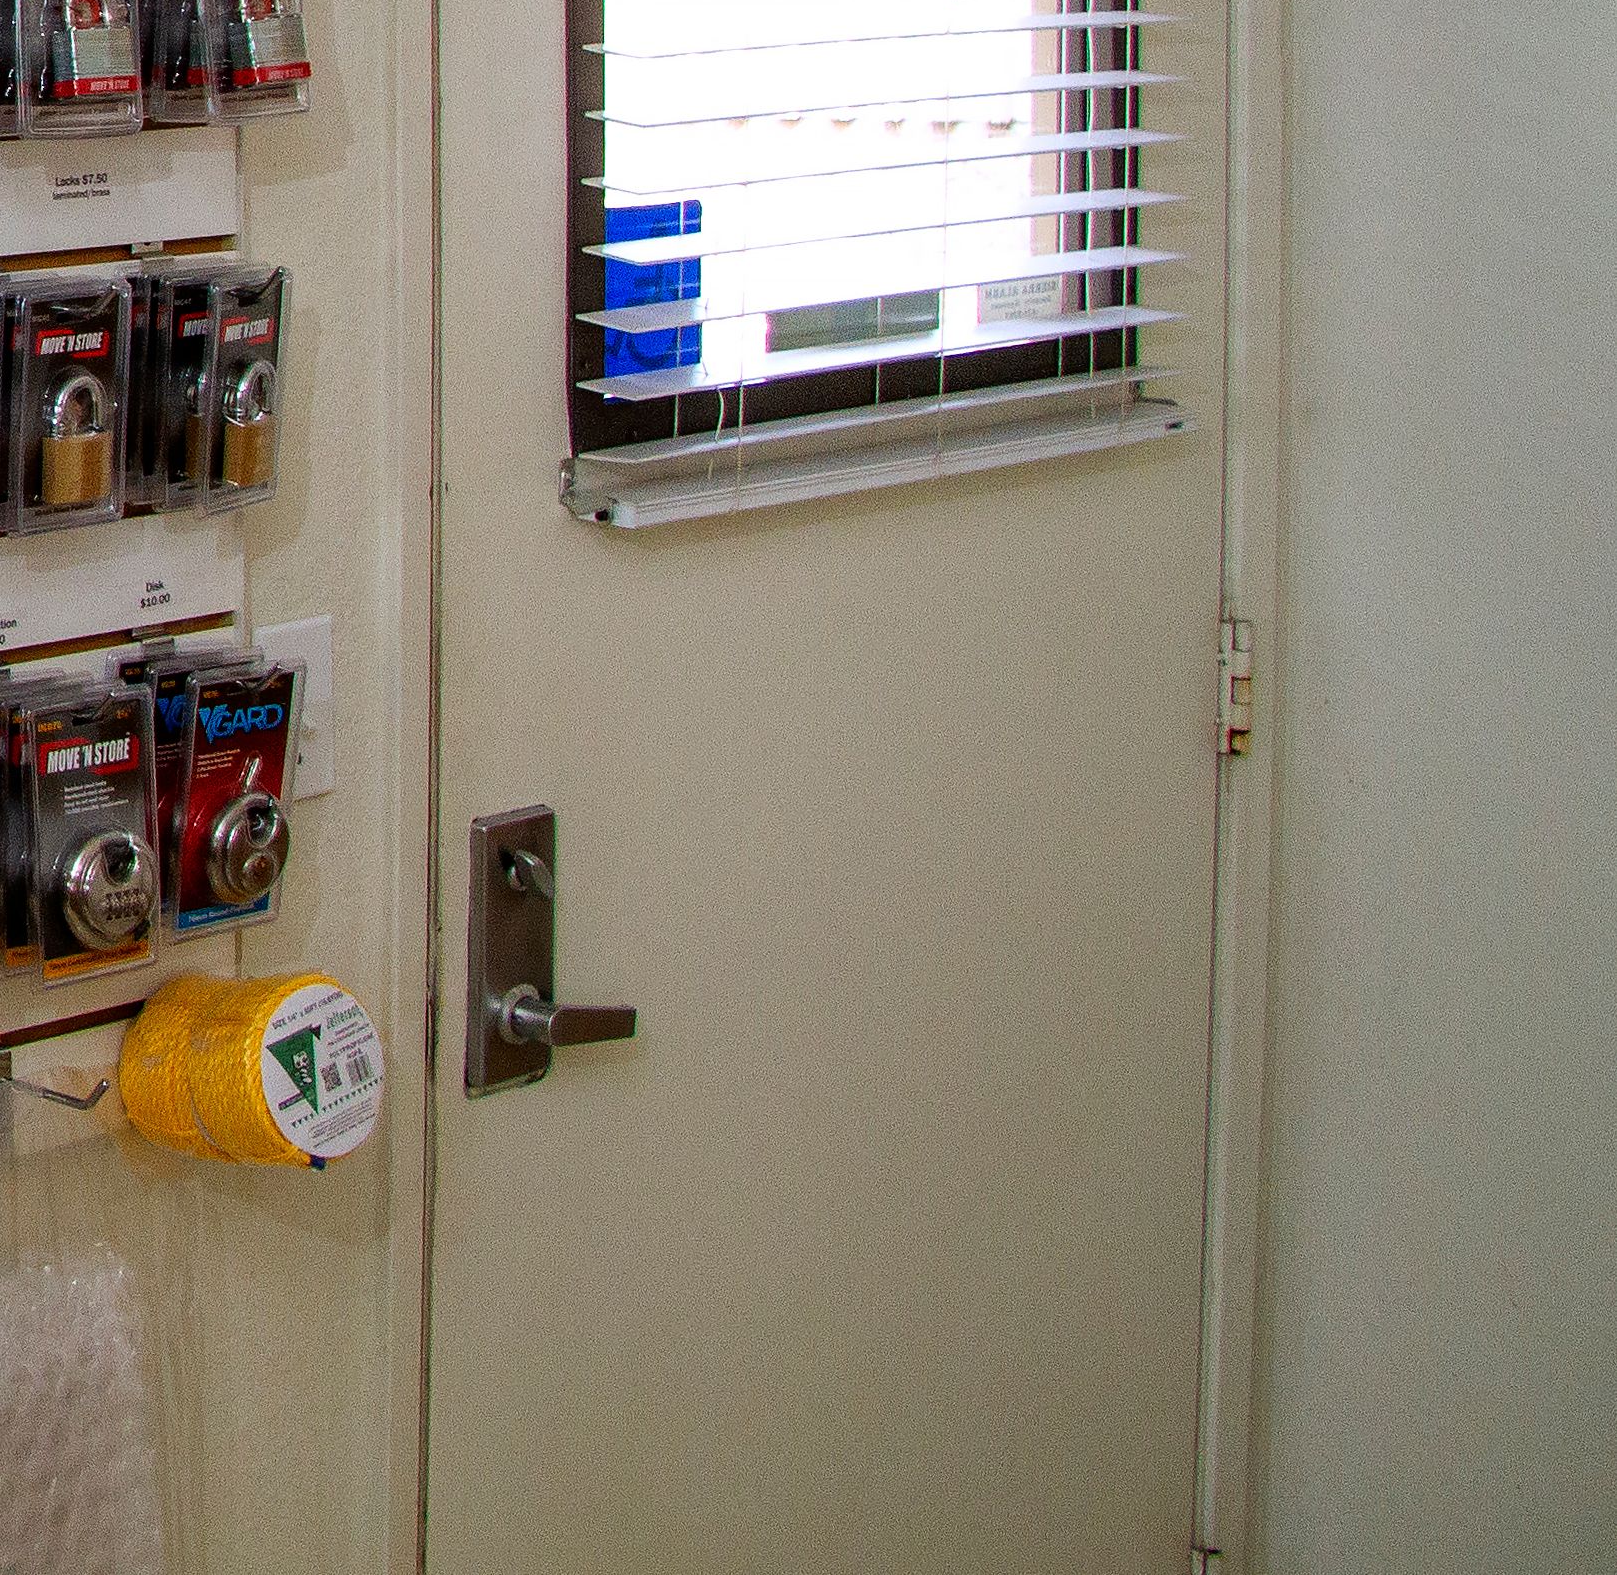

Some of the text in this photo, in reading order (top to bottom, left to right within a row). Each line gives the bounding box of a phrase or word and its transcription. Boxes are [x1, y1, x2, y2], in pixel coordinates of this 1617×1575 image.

[55, 175, 80, 187] Locks
[146, 580, 164, 592] Disk
[47, 746, 81, 774] MOVE
[94, 738, 130, 766] STORE
